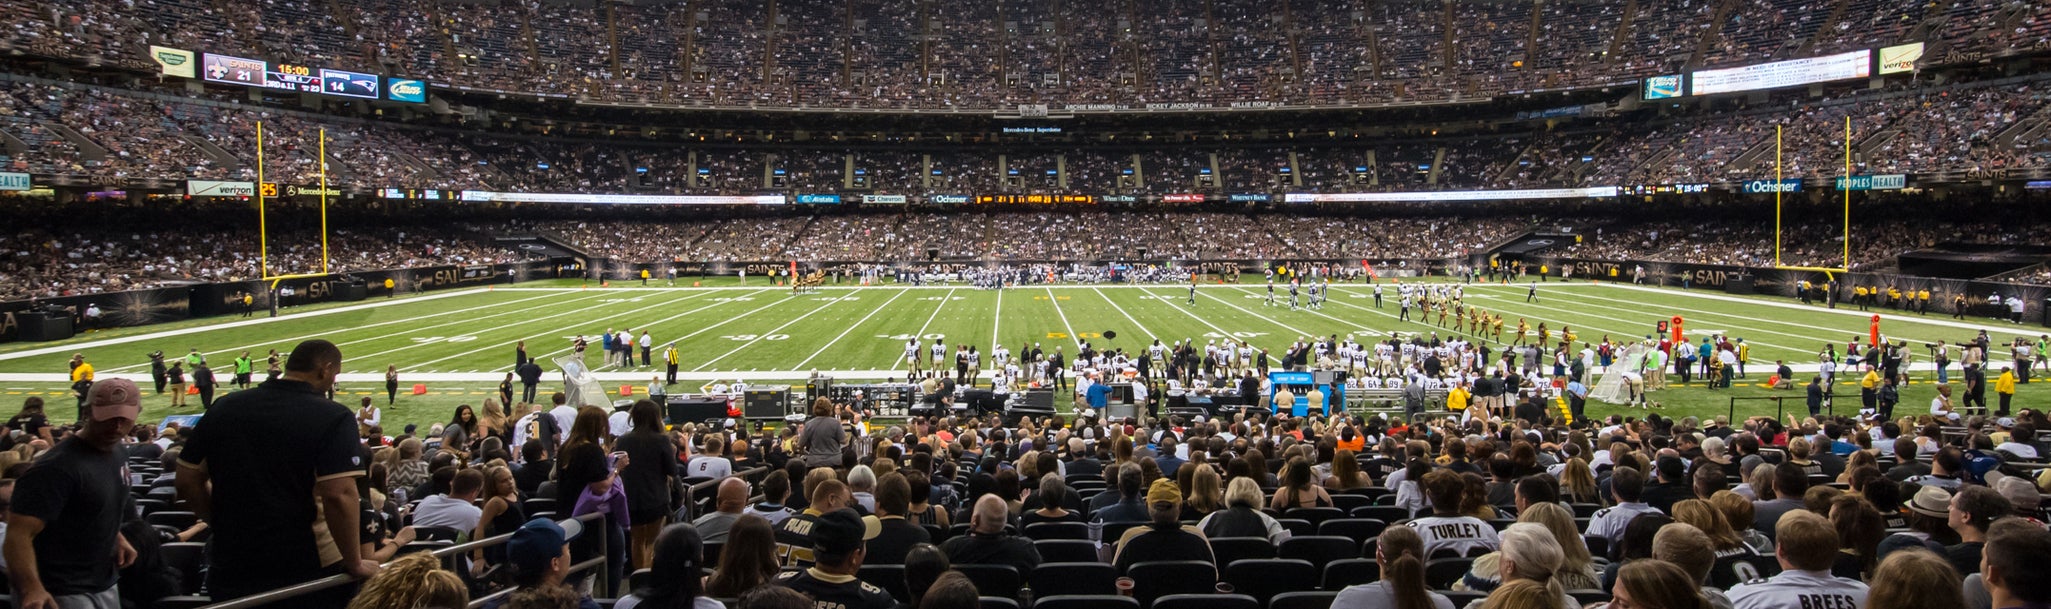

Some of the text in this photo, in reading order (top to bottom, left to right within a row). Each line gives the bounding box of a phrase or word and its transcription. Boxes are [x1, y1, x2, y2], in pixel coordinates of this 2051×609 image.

[1944, 52, 1981, 64] SAINTS
[230, 61, 261, 71] SAINTS
[278, 64, 309, 76] 15:00
[1883, 61, 1914, 70] verizo
[237, 70, 251, 81] 21
[330, 82, 345, 92] 14
[1967, 170, 2006, 180] SAINTS
[91, 175, 129, 187] SAINTS
[1837, 176, 1904, 189] PEOPLES HEALTH
[219, 185, 251, 195] verizon
[262, 184, 277, 196] 25
[298, 187, 341, 196] Mercede-Benz
[1684, 184, 1702, 192] 15:00
[1752, 181, 1797, 193] Ochsner
[936, 195, 967, 203] Ochsner
[747, 264, 785, 274] SAINTS
[1076, 364, 1084, 372] 12
[700, 461, 706, 471] 6
[783, 518, 813, 536] FUJITA
[1429, 523, 1482, 540] TURLEY
[1798, 594, 1857, 609] BREES
